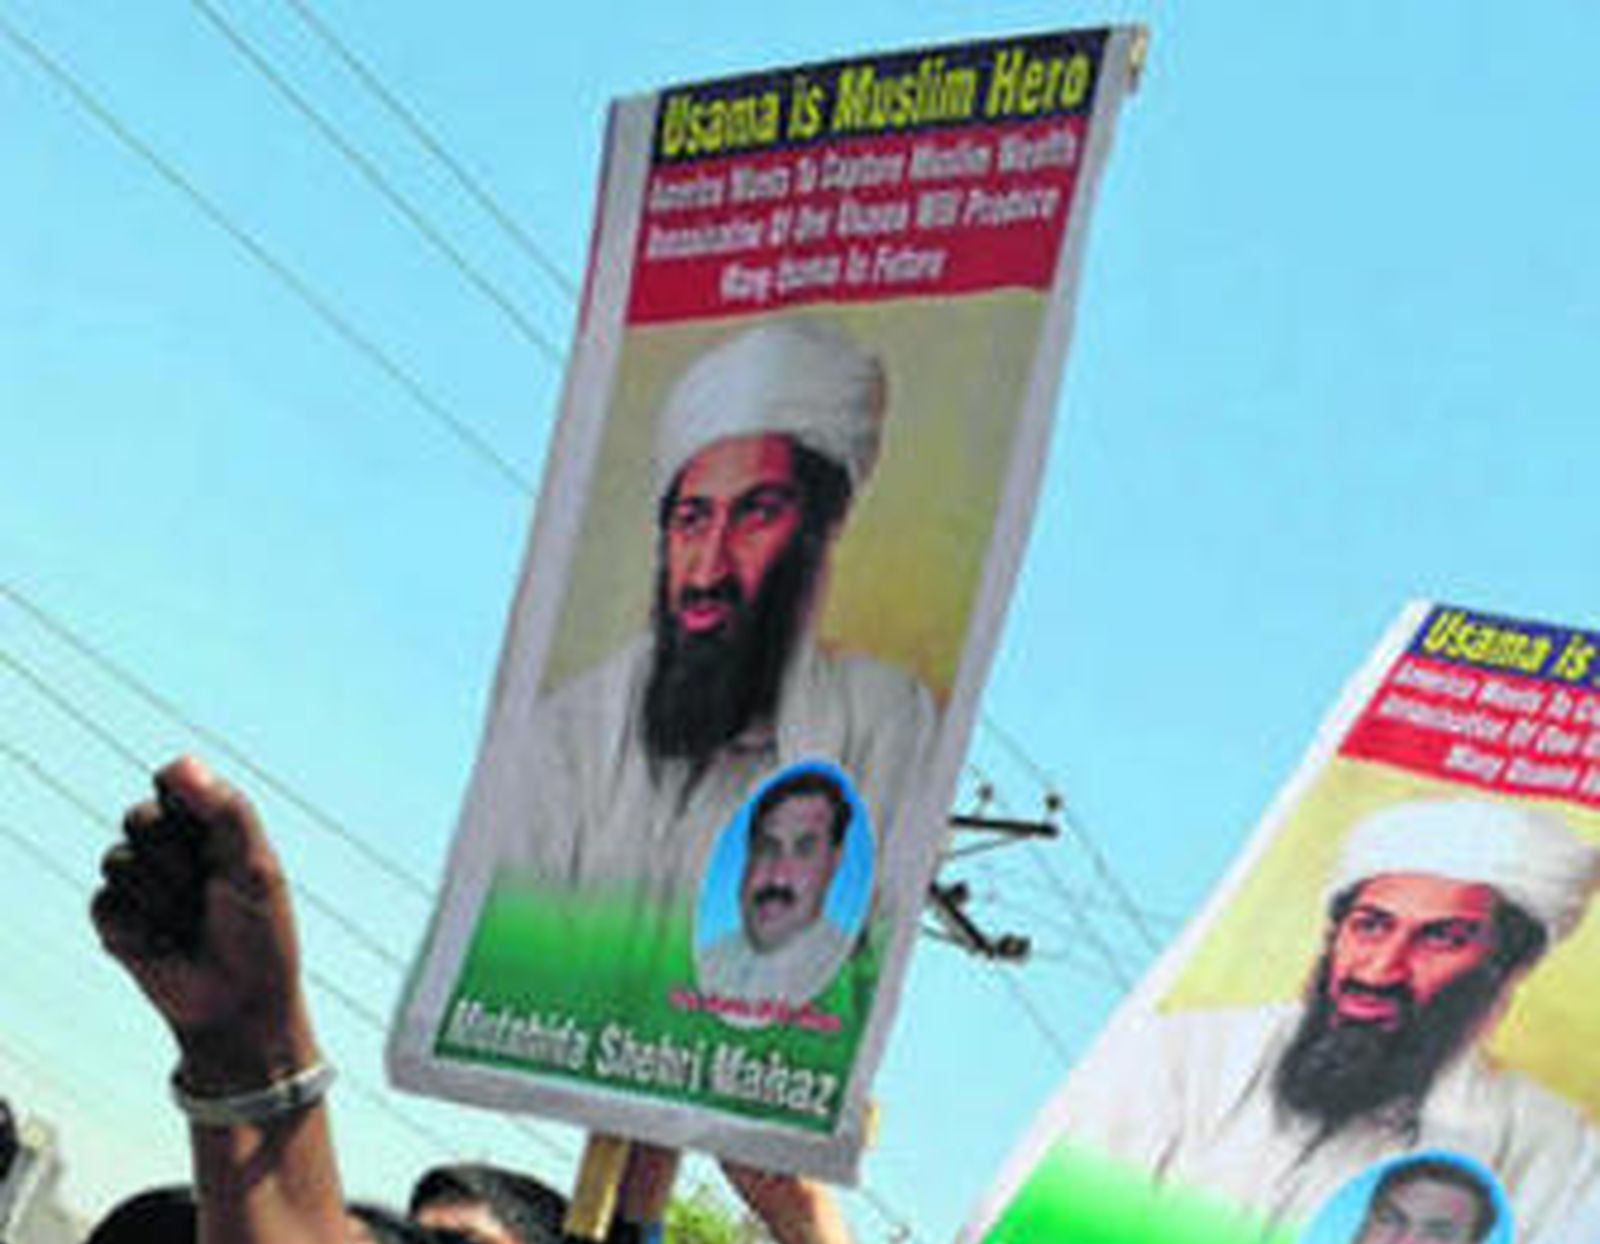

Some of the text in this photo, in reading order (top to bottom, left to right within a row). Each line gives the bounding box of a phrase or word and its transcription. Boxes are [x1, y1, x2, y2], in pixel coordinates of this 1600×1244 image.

[663, 90, 780, 156] Usama
[833, 57, 977, 132] Muslim
[986, 48, 1090, 116] Hero
[1422, 610, 1552, 675] Usama
[595, 1022, 706, 1091] Shehri
[713, 1041, 840, 1117] Mahaz
